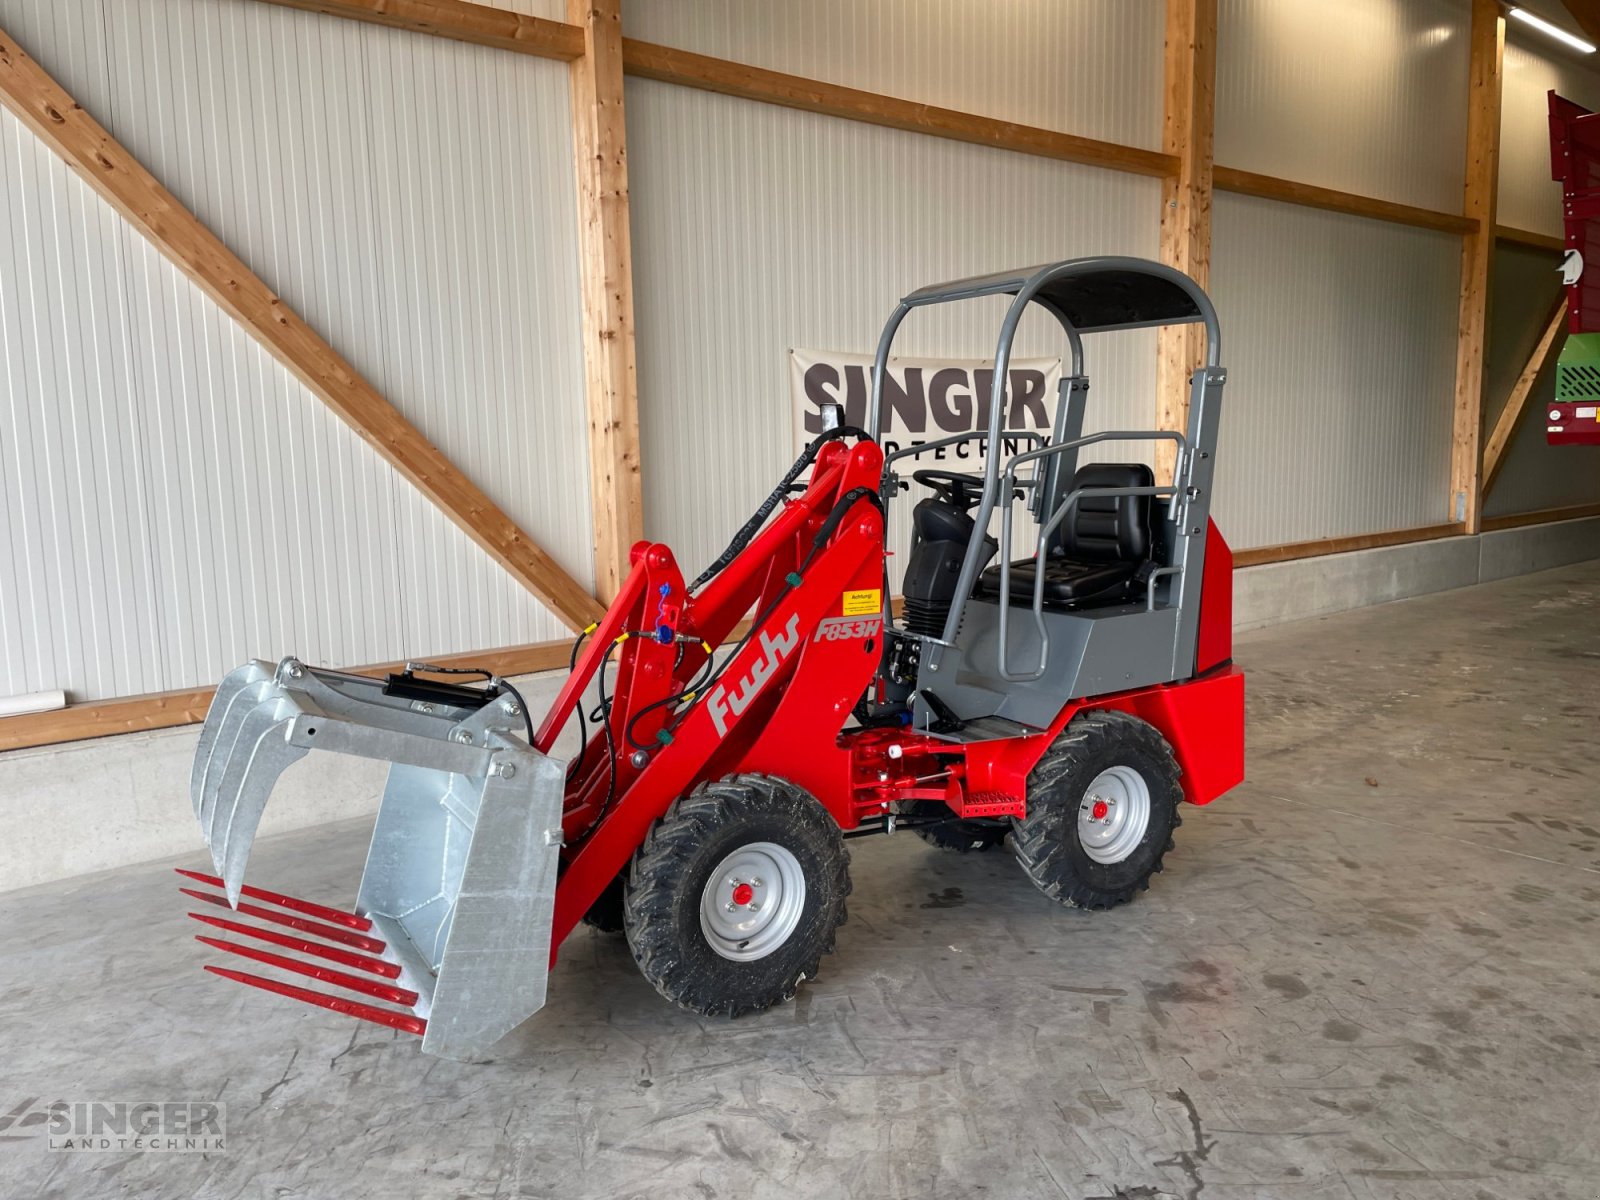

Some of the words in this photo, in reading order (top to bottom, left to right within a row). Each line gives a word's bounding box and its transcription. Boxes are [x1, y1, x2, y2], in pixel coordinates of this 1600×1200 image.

[804, 363, 1050, 433] SINGER
[804, 436, 1052, 464] DTECHNIK
[813, 613, 881, 643] F853H
[706, 612, 800, 739] Fuchs
